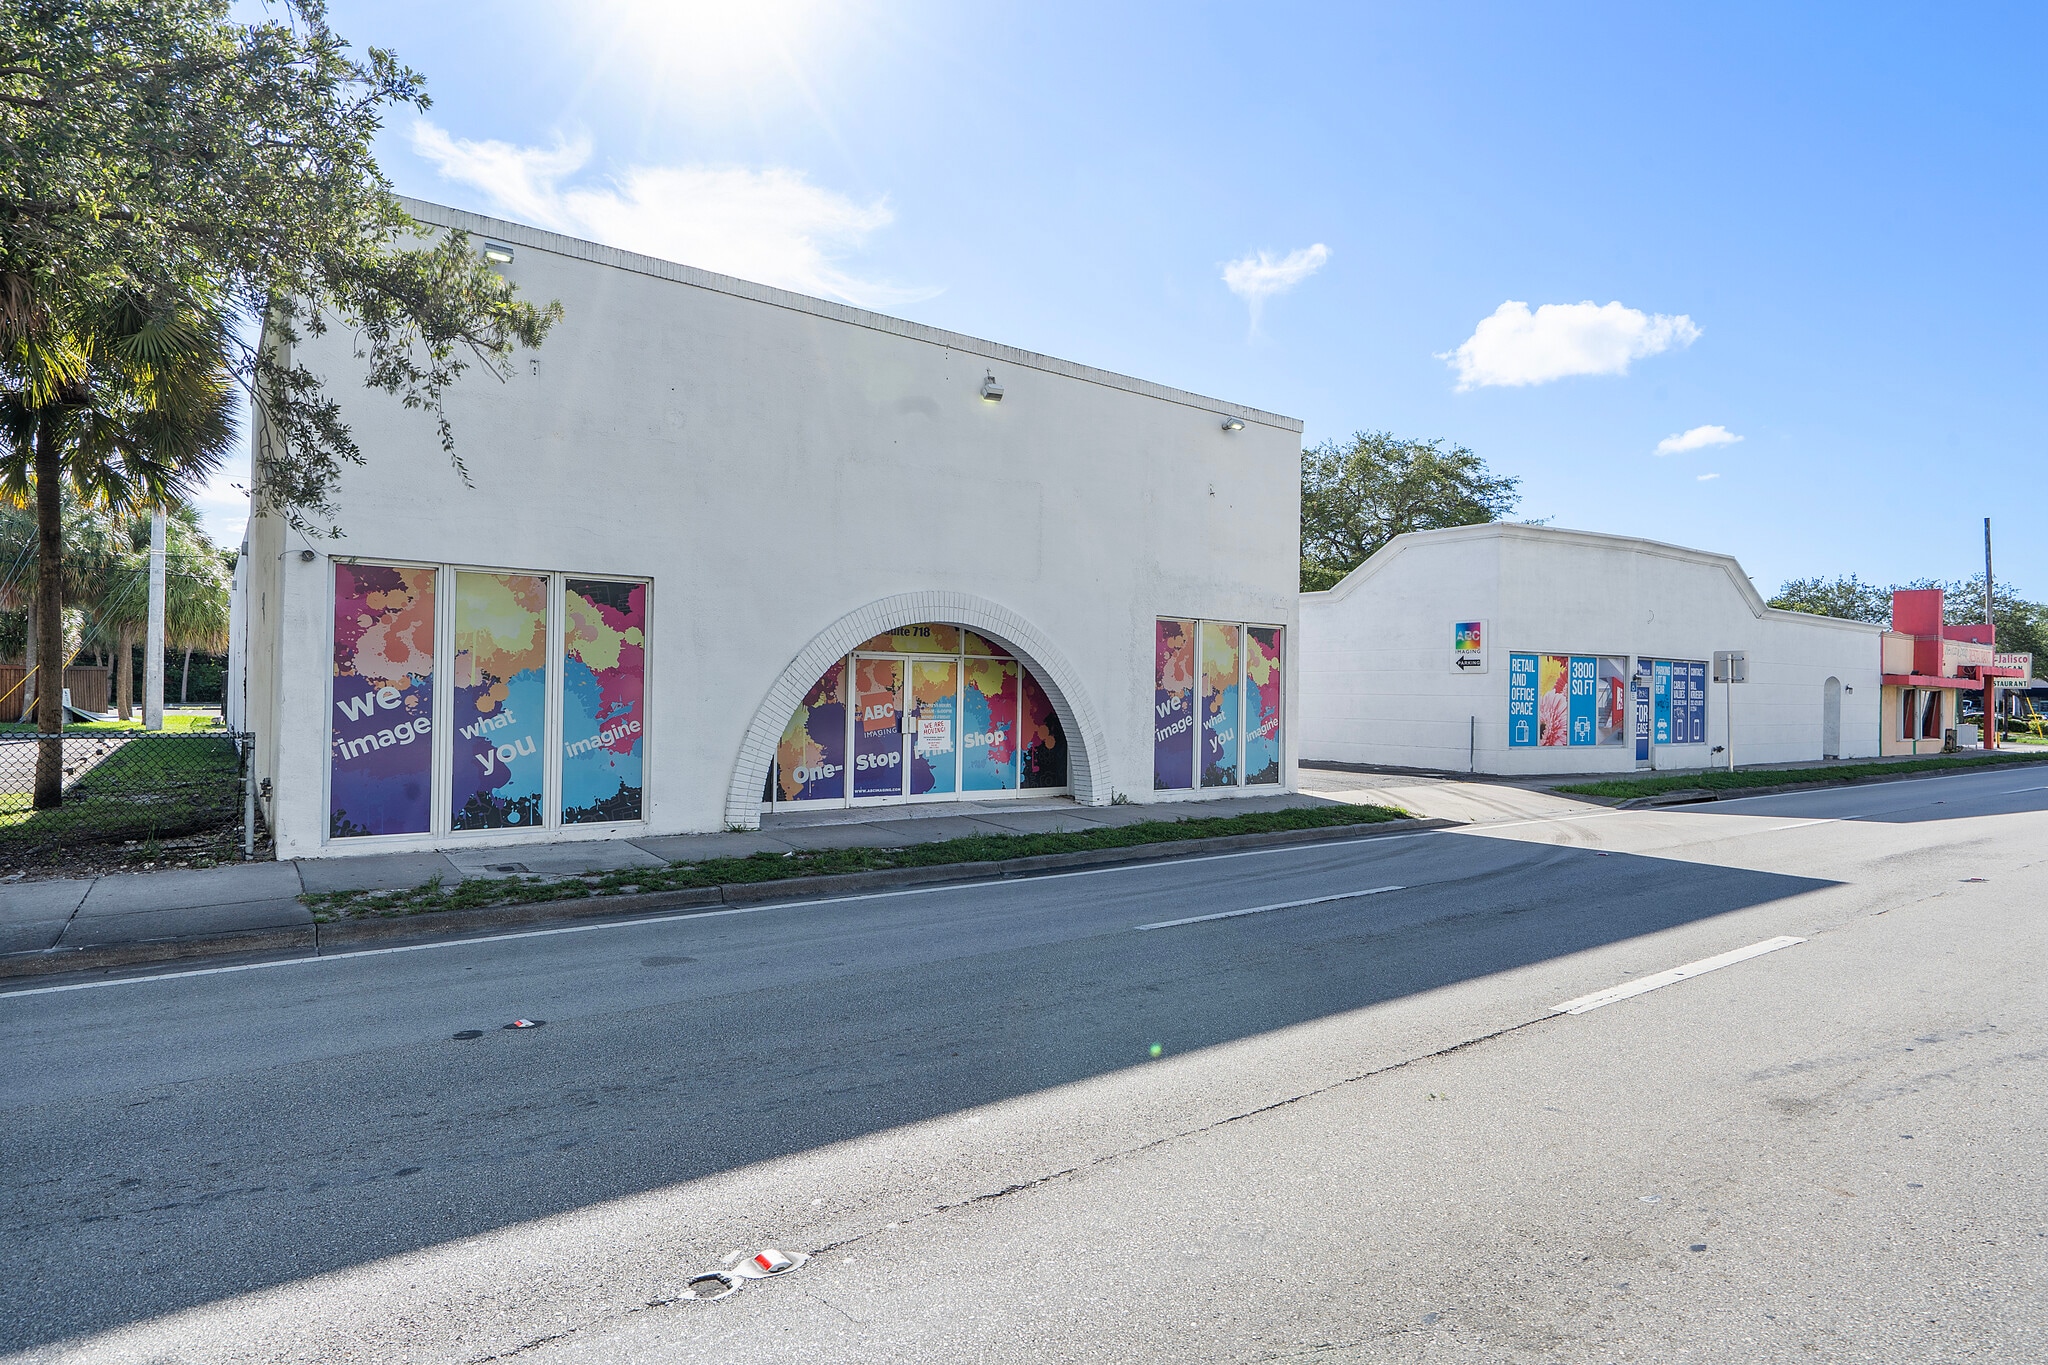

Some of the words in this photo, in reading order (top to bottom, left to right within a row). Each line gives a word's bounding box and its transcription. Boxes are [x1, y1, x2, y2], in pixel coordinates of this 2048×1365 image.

[912, 626, 930, 637] 718
[1456, 630, 1480, 641] ABC
[1511, 658, 1535, 673] RETAIL
[1572, 662, 1594, 679] 3800
[1511, 673, 1527, 686] AND
[1572, 680, 1583, 695] SQ
[1584, 680, 1594, 695] FT
[1511, 687, 1535, 701] OFFICE
[864, 703, 894, 721] ABC
[1511, 701, 1534, 715] SPACE
[459, 708, 517, 740] what
[1156, 714, 1193, 743] image
[1203, 710, 1226, 730] what
[1636, 723, 1648, 734] EASE
[338, 715, 432, 761] image
[565, 717, 641, 759] imagine
[864, 727, 898, 738] IMAGING
[1246, 717, 1279, 743] imagine
[1209, 727, 1235, 753] you
[475, 735, 537, 777] you
[793, 764, 843, 784] One-
[856, 751, 901, 771] Stop
[964, 731, 1005, 748] Shop
